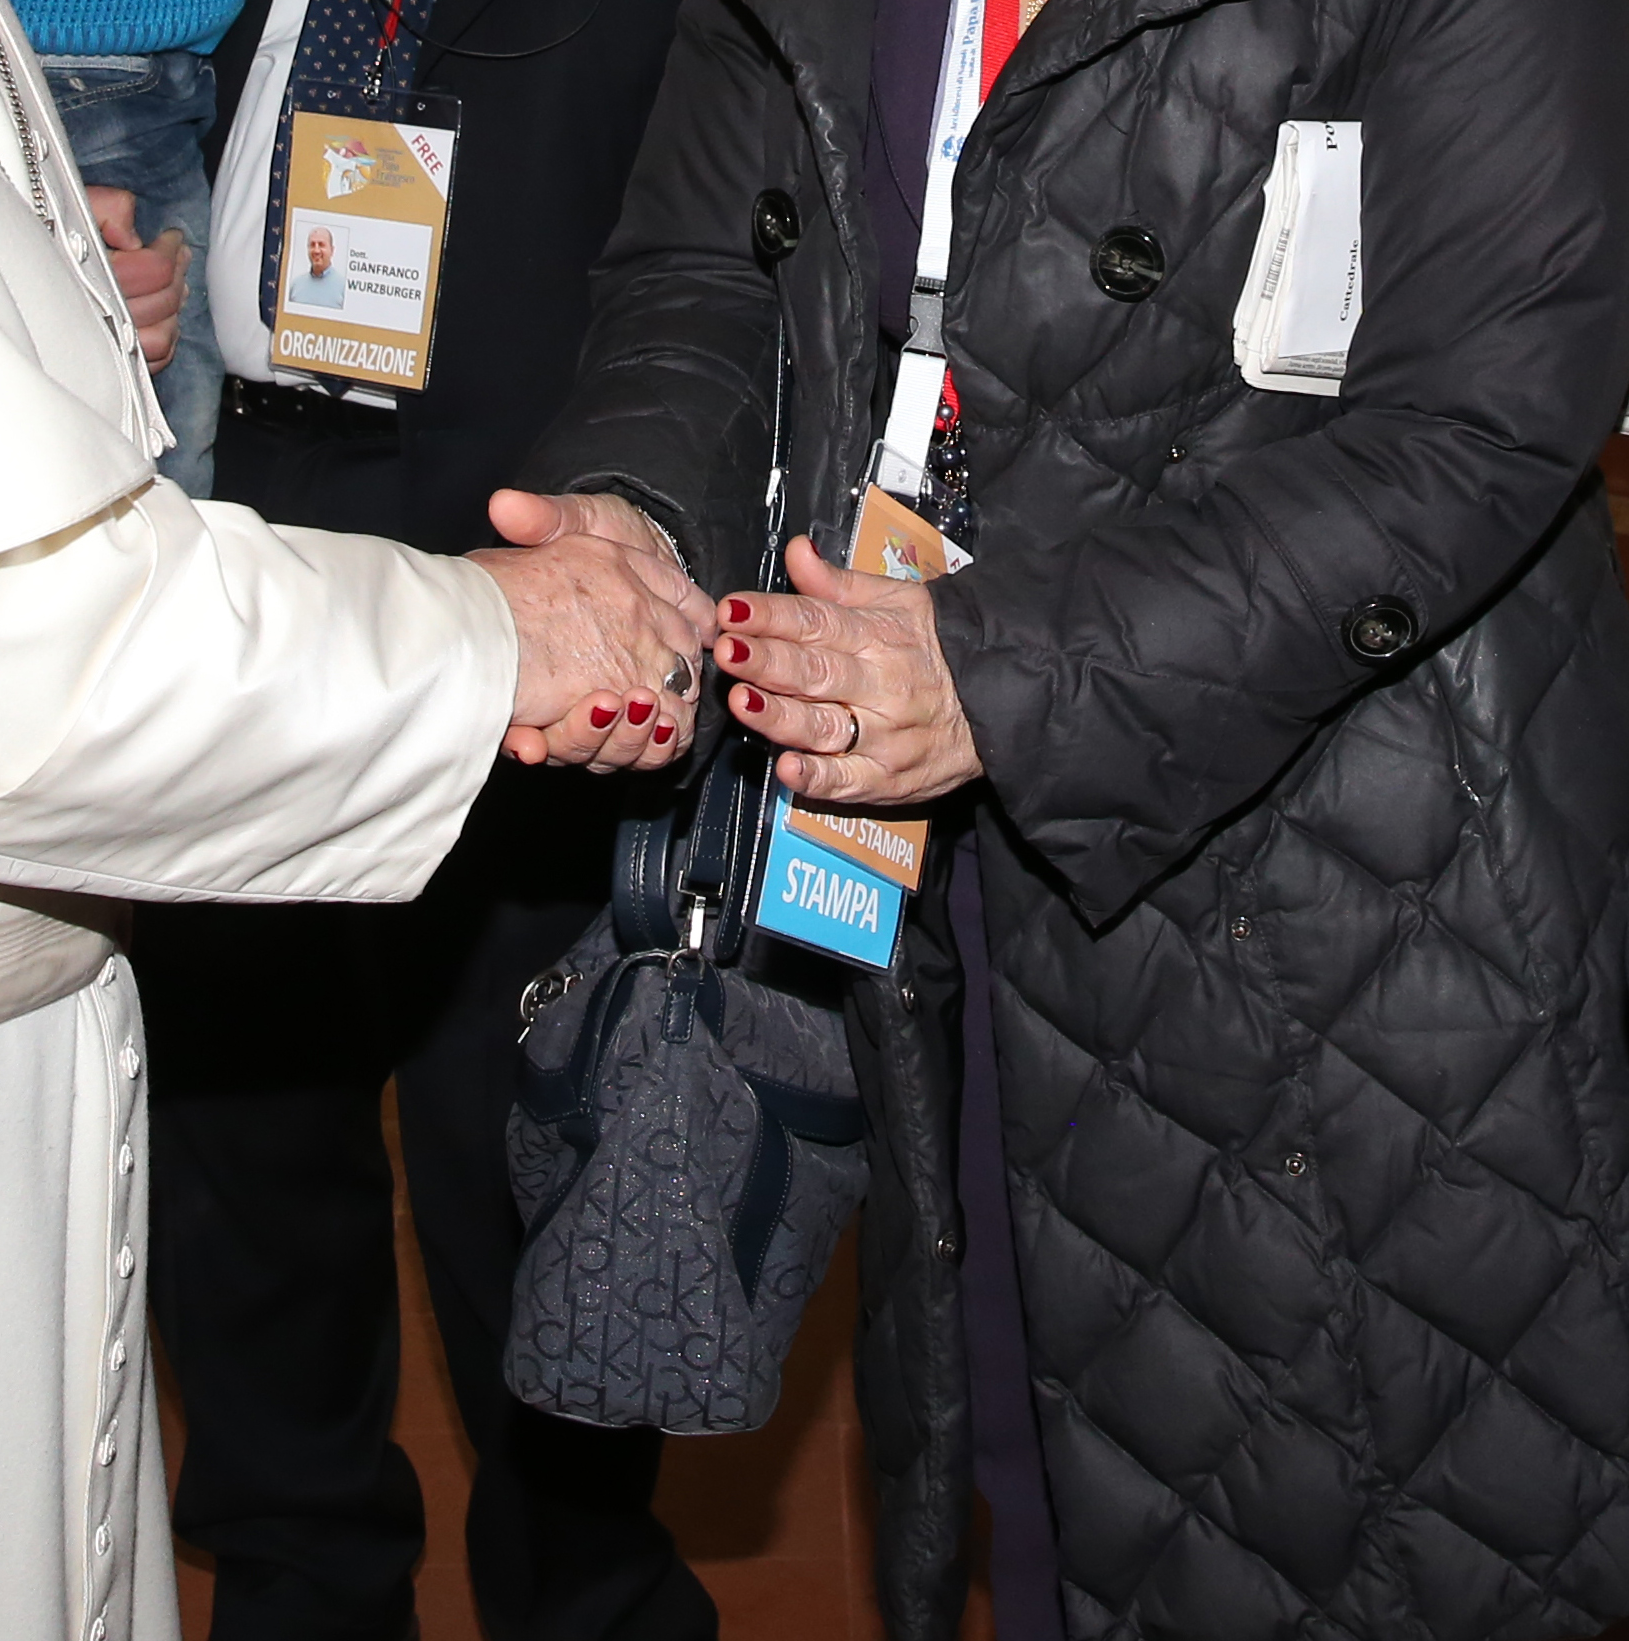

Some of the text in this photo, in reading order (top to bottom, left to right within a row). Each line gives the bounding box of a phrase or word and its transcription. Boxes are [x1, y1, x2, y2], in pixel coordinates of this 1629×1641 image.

[962, 6, 979, 45] Papa
[410, 133, 444, 176] FREE
[348, 261, 420, 280] GIANFRANCO
[349, 248, 369, 260] Dott.
[347, 280, 422, 301] WURZBURGER
[1339, 239, 1360, 322] Cattedrale
[279, 329, 417, 377] ORGANIZZAZIONE
[857, 818, 915, 871] STAMPA
[781, 858, 880, 934] STAMPA
